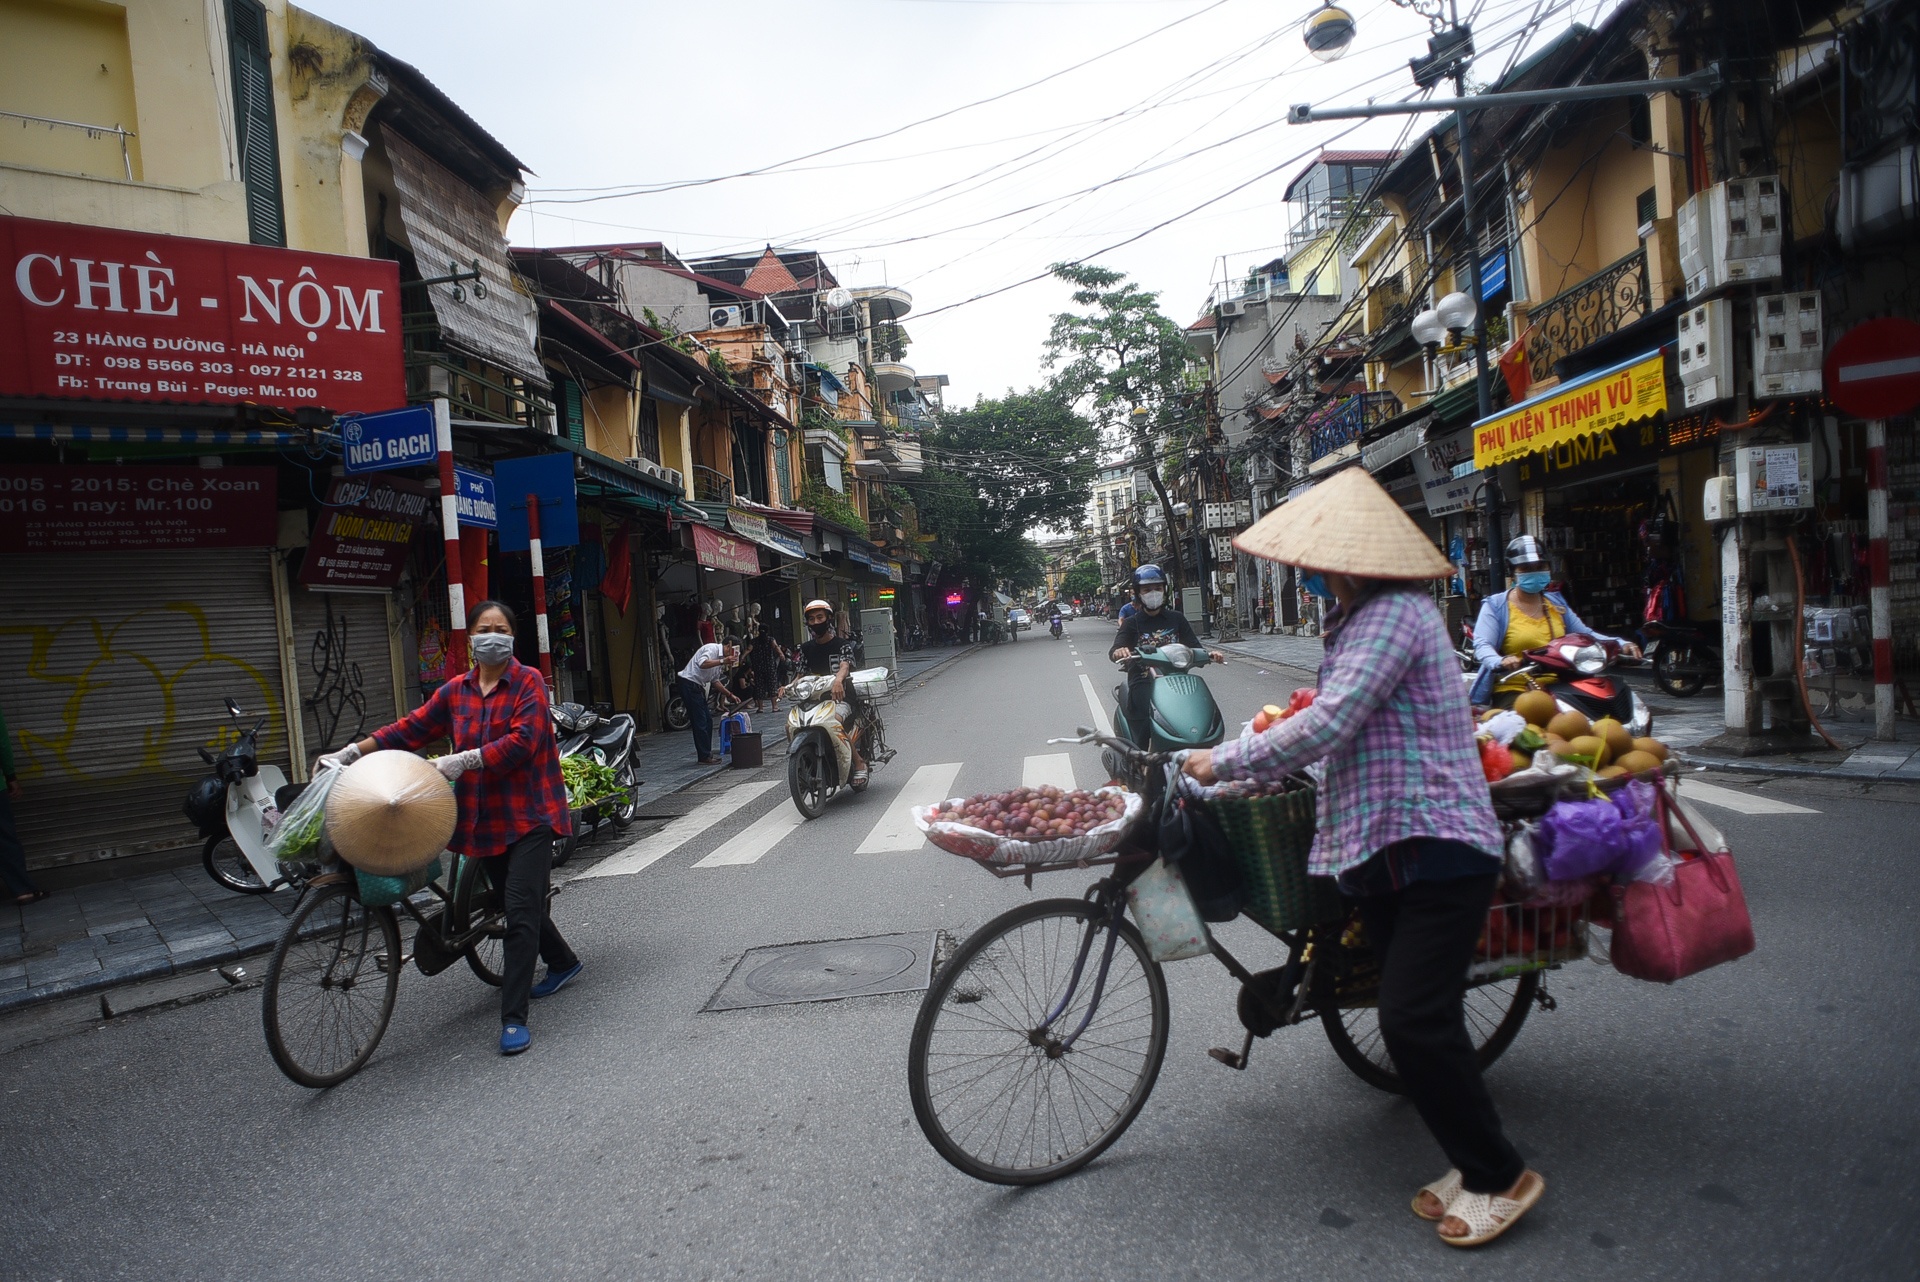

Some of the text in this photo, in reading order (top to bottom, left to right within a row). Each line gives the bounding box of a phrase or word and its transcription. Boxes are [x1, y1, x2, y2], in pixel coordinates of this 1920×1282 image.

[15, 250, 386, 342] CHÈ - NỘM
[53, 331, 79, 344] 23
[86, 331, 147, 349] HÀNG
[152, 337, 226, 353] ĐƯỜNG
[242, 342, 268, 356] HÀ
[273, 344, 305, 361] NỘI
[54, 353, 91, 367] ĐT:
[103, 356, 141, 369] 098
[147, 359, 194, 372] 5566
[200, 362, 234, 374] 303
[249, 364, 281, 377] 097
[287, 367, 326, 380] 2121
[332, 370, 363, 382] 328
[57, 375, 89, 388] Fb:
[94, 377, 151, 394] Trang
[157, 380, 187, 393] Bùi
[204, 382, 254, 397] Page:
[259, 385, 318, 399] Mr.100
[1479, 425, 1506, 454] PHỤ
[1509, 409, 1545, 443] KIỆN
[1549, 388, 1601, 427] THỊNH
[1606, 370, 1633, 409] VŨ
[350, 433, 431, 465] NGÕ GẠCH
[1539, 428, 1618, 473] TOMA
[70, 477, 138, 492] 2015:
[147, 478, 195, 492] Chè
[202, 478, 261, 491] Xoan
[469, 481, 485, 494] PHỐ
[72, 500, 126, 515] nay:
[135, 498, 213, 511] Mr.100
[396, 492, 427, 517] CHUA
[473, 496, 497, 521] ĐƯỜNG
[333, 512, 364, 542] NỘM
[717, 536, 736, 557] 27
